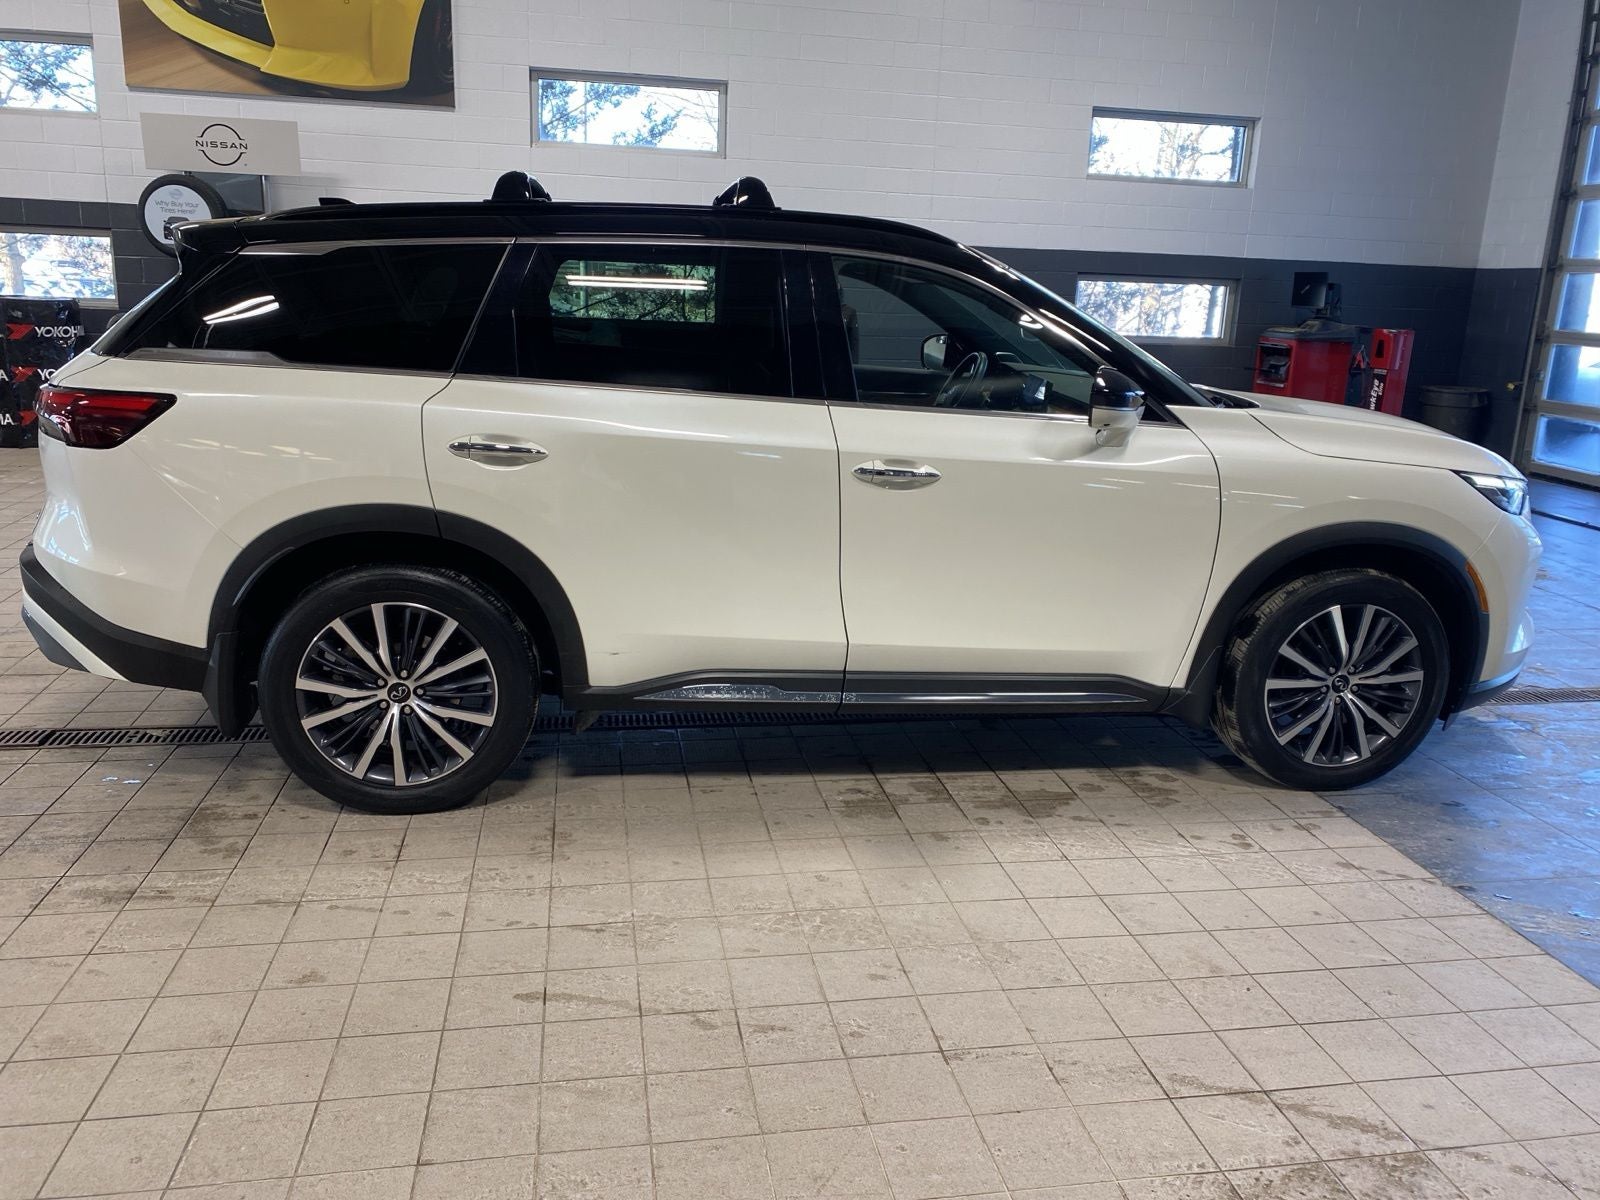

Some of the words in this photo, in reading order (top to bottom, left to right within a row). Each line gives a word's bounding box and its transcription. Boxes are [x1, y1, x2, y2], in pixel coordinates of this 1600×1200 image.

[195, 140, 248, 150] NISSAN
[171, 200, 183, 208] Buy
[160, 206, 176, 214] Tires
